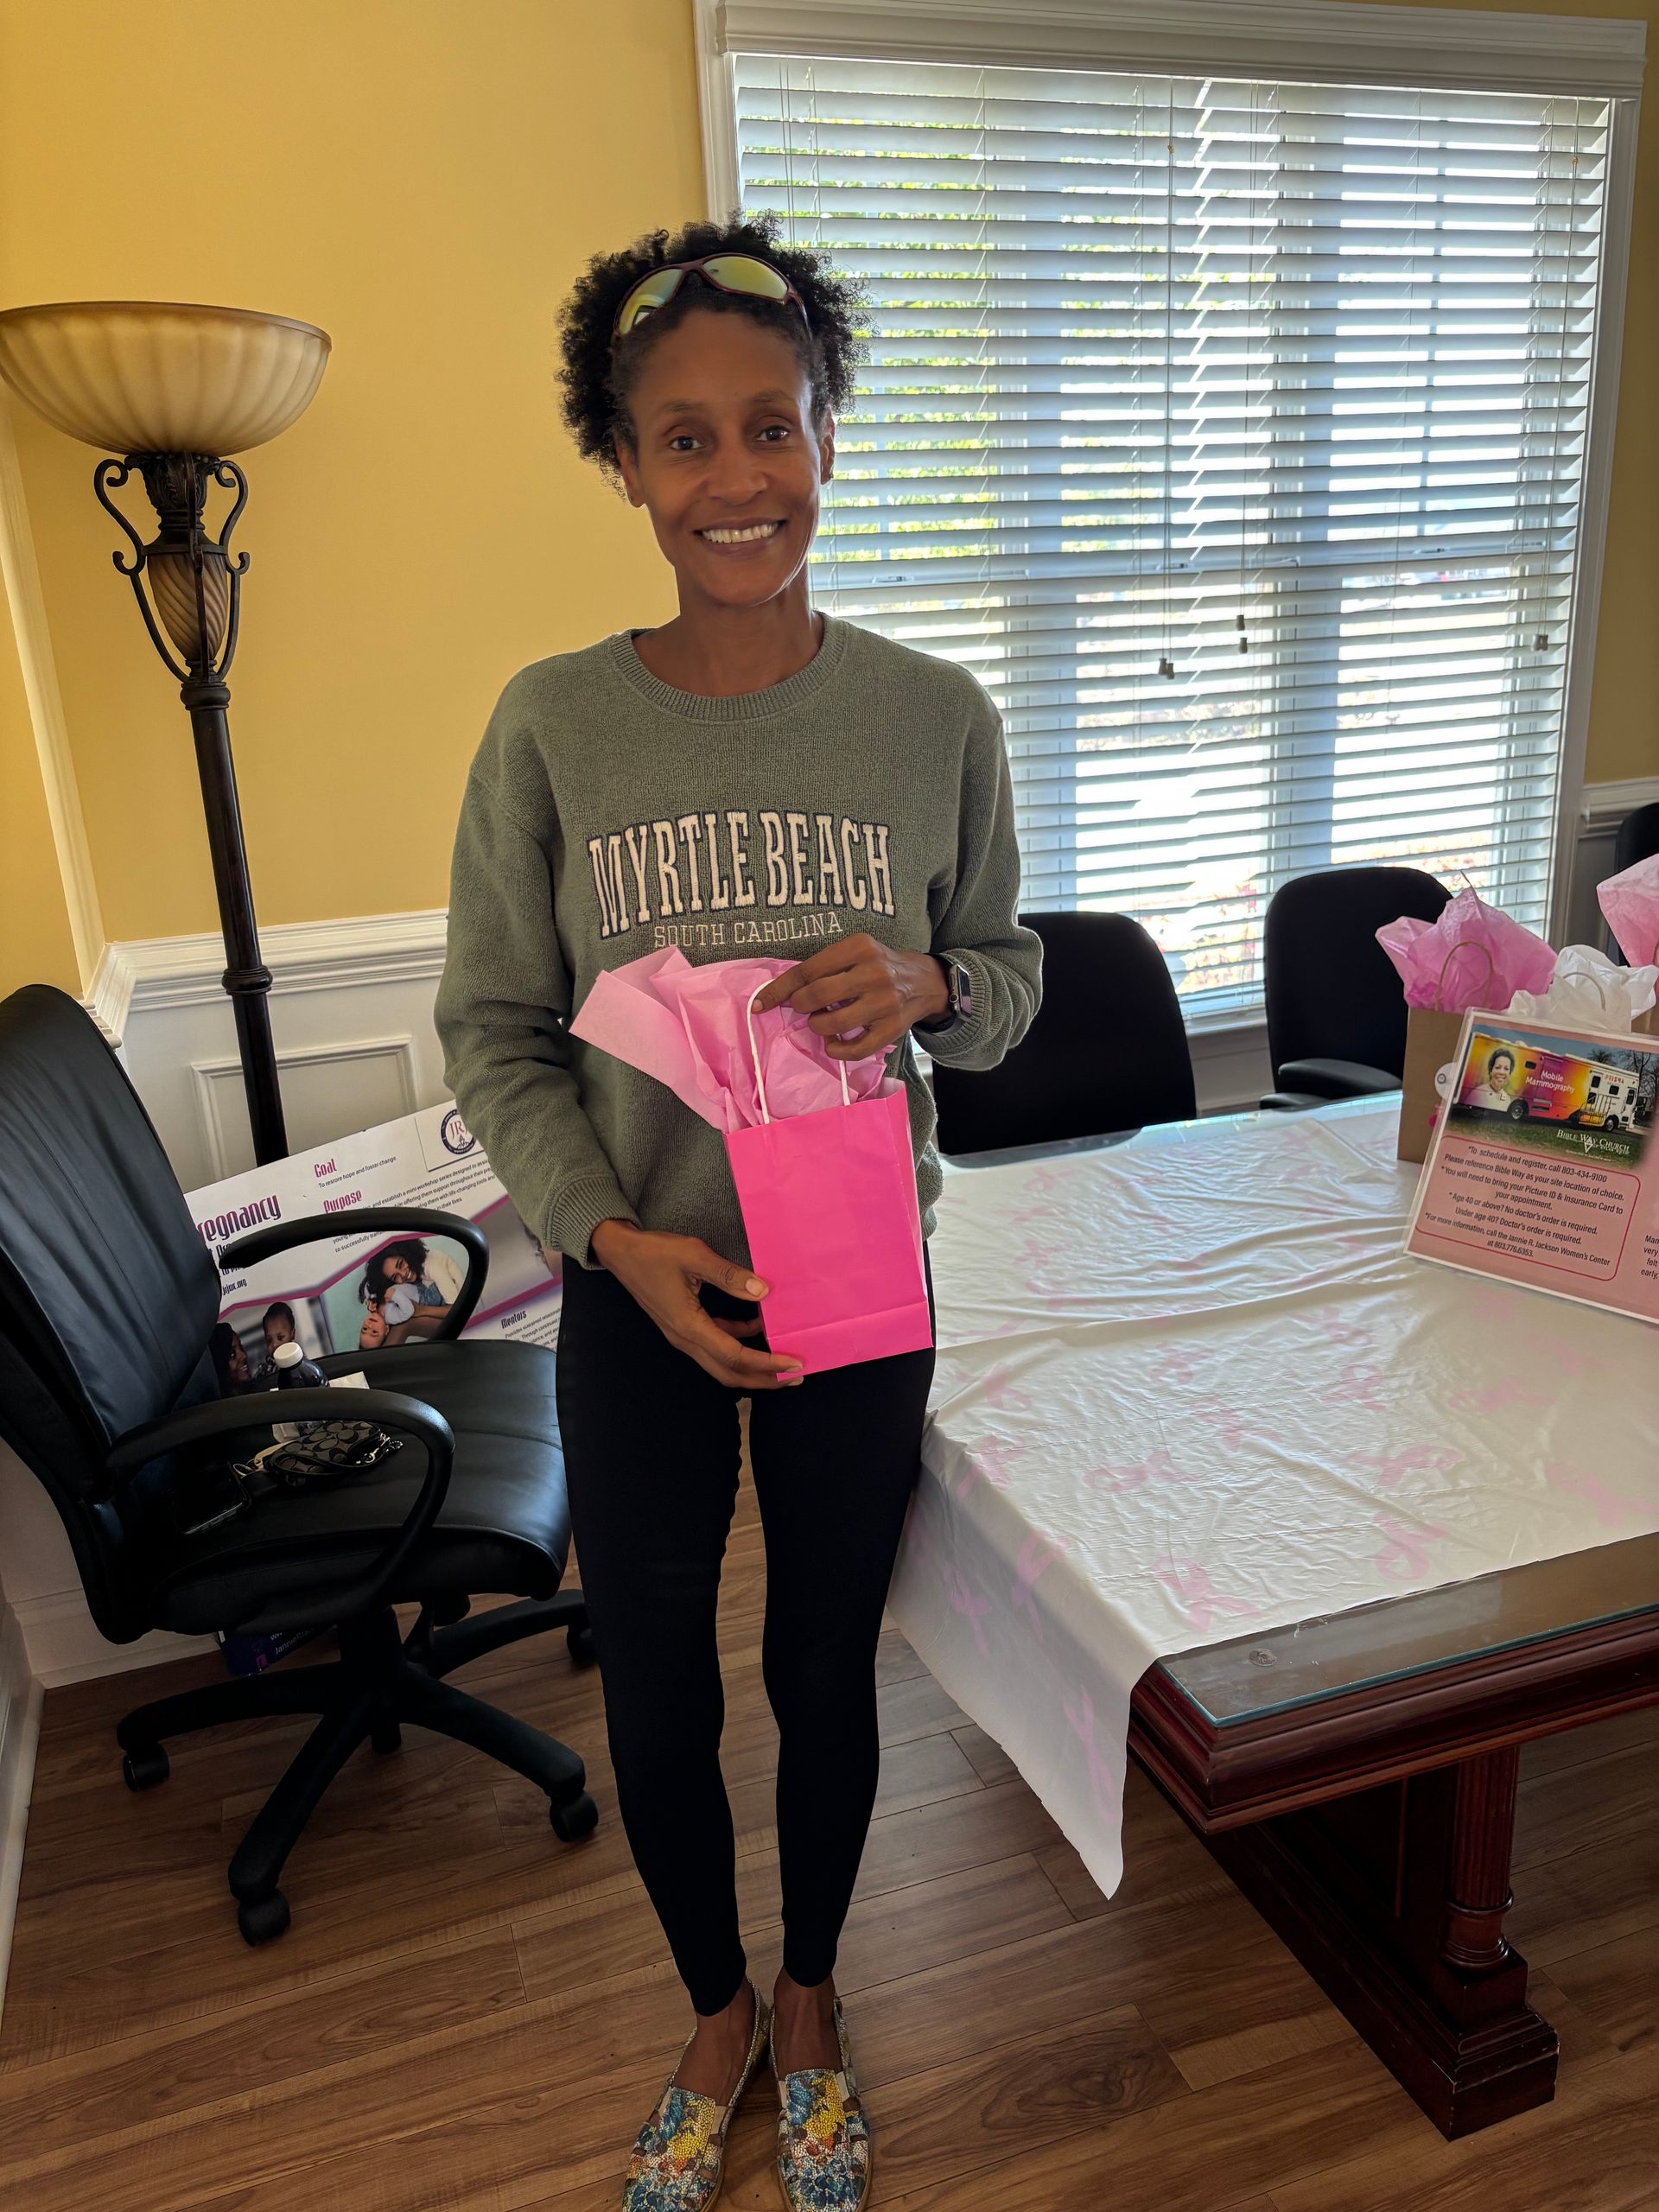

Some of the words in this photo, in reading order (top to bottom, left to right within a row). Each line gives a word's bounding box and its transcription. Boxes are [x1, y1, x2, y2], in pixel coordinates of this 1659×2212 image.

[588, 810, 757, 939] MYRTLE
[758, 810, 896, 918] BEACH
[654, 925, 726, 949] SOUTH
[734, 911, 843, 945] CAROLINA
[1525, 1076, 1575, 1094] Mammography
[1541, 1071, 1563, 1082] Mobile
[1599, 1138, 1630, 1152] CHURCH
[314, 1158, 338, 1178] Goal
[326, 1176, 343, 1186] restore
[343, 1171, 355, 1181] hope
[365, 1162, 379, 1172] foster
[1445, 1154, 1465, 1165] Please
[1465, 1159, 1494, 1172] reference
[1495, 1165, 1510, 1175] Bible
[1511, 1169, 1525, 1180] Way
[1535, 1175, 1549, 1184] your
[1550, 1177, 1563, 1187] site
[1563, 1180, 1591, 1193] location
[1592, 1186, 1599, 1195] of
[1599, 1189, 1624, 1201] choice.
[1479, 1148, 1508, 1161] schedule
[1508, 1154, 1521, 1164] and
[1522, 1158, 1548, 1170] register,
[1548, 1164, 1561, 1173] call
[1561, 1166, 1607, 1183] 803-434-9100
[382, 1192, 403, 1205] establish
[439, 1173, 452, 1182] series
[452, 1165, 472, 1176] designed
[404, 1195, 421, 1205] offering
[433, 1184, 449, 1193] support
[1445, 1166, 1456, 1175] You
[1457, 1169, 1468, 1178] will
[1469, 1172, 1484, 1182] need
[1484, 1175, 1491, 1184] to
[1491, 1176, 1508, 1190] bring
[1509, 1182, 1524, 1192] your
[1524, 1185, 1548, 1198] Picture
[1548, 1191, 1556, 1199] ID
[1563, 1194, 1598, 1209] Insurance
[1599, 1202, 1615, 1213] Card
[1616, 1206, 1624, 1215] to
[323, 1190, 363, 1214] Purpose
[428, 1197, 440, 1205] them
[1494, 1191, 1510, 1200] your
[1510, 1194, 1553, 1210] appointment.
[1452, 1193, 1465, 1203] Age
[1465, 1196, 1473, 1205] 40
[1482, 1200, 1504, 1212] above?
[1505, 1205, 1514, 1214] No
[1515, 1207, 1541, 1221] doctor's
[1541, 1215, 1560, 1225] order
[1560, 1218, 1567, 1227] is
[1567, 1222, 1598, 1235] required.
[1455, 1207, 1474, 1217] Under
[1474, 1213, 1486, 1222] age
[1486, 1215, 1499, 1224] 40?
[1499, 1217, 1526, 1230] Doctor's
[1526, 1225, 1544, 1235] order
[1552, 1231, 1582, 1244] required.
[1437, 1216, 1452, 1226] more
[1452, 1219, 1486, 1235] information,
[1486, 1229, 1497, 1238] call
[1497, 1231, 1508, 1240] the
[1508, 1233, 1528, 1245] Jannie
[1528, 1238, 1535, 1247] R.
[1535, 1241, 1560, 1253] Jackson
[1560, 1247, 1588, 1261] Women's
[1589, 1254, 1611, 1266] Center
[1643, 1247, 1659, 1257] very
[1646, 1258, 1658, 1267] felt
